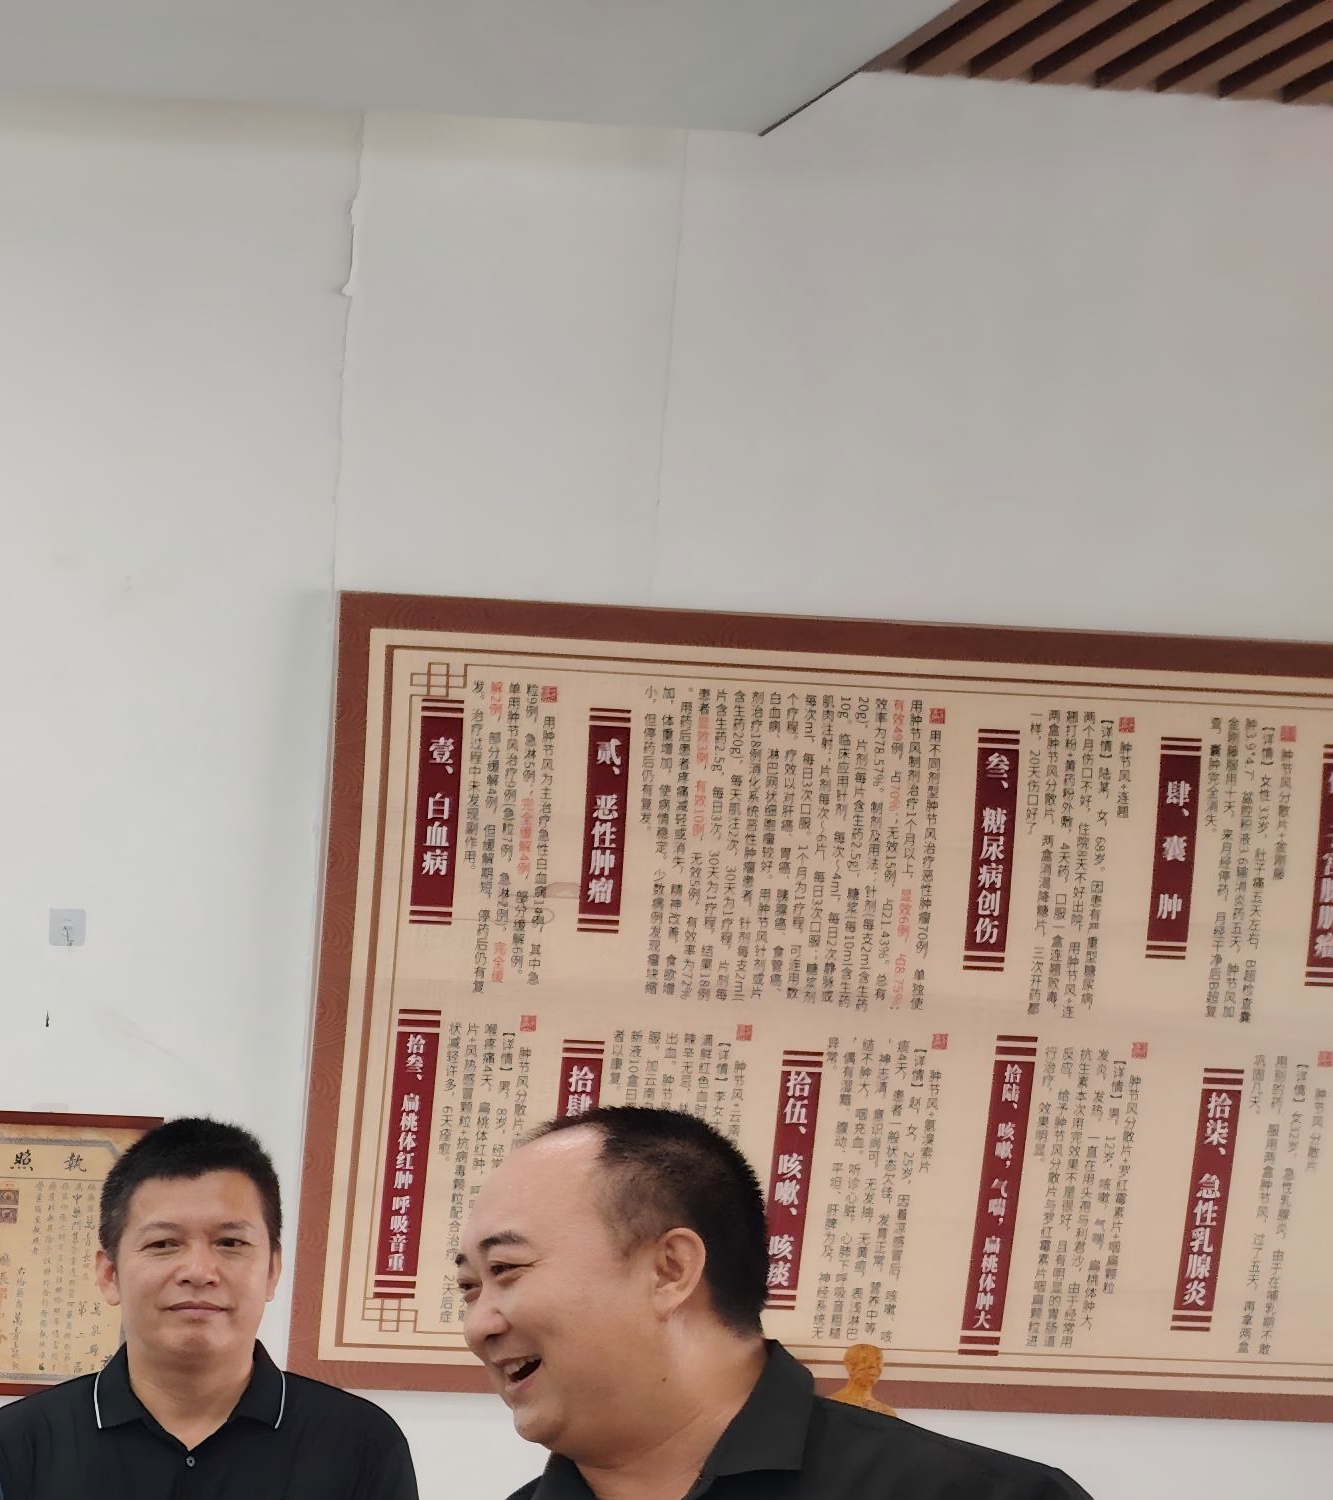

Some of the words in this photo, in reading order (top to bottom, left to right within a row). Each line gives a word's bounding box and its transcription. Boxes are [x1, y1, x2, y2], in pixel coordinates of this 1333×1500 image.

[421, 736, 454, 876] 壹、白血病
[588, 737, 622, 904] 贰、恶性肿瘤
[974, 752, 1010, 944] 叁、糖尿病创伤
